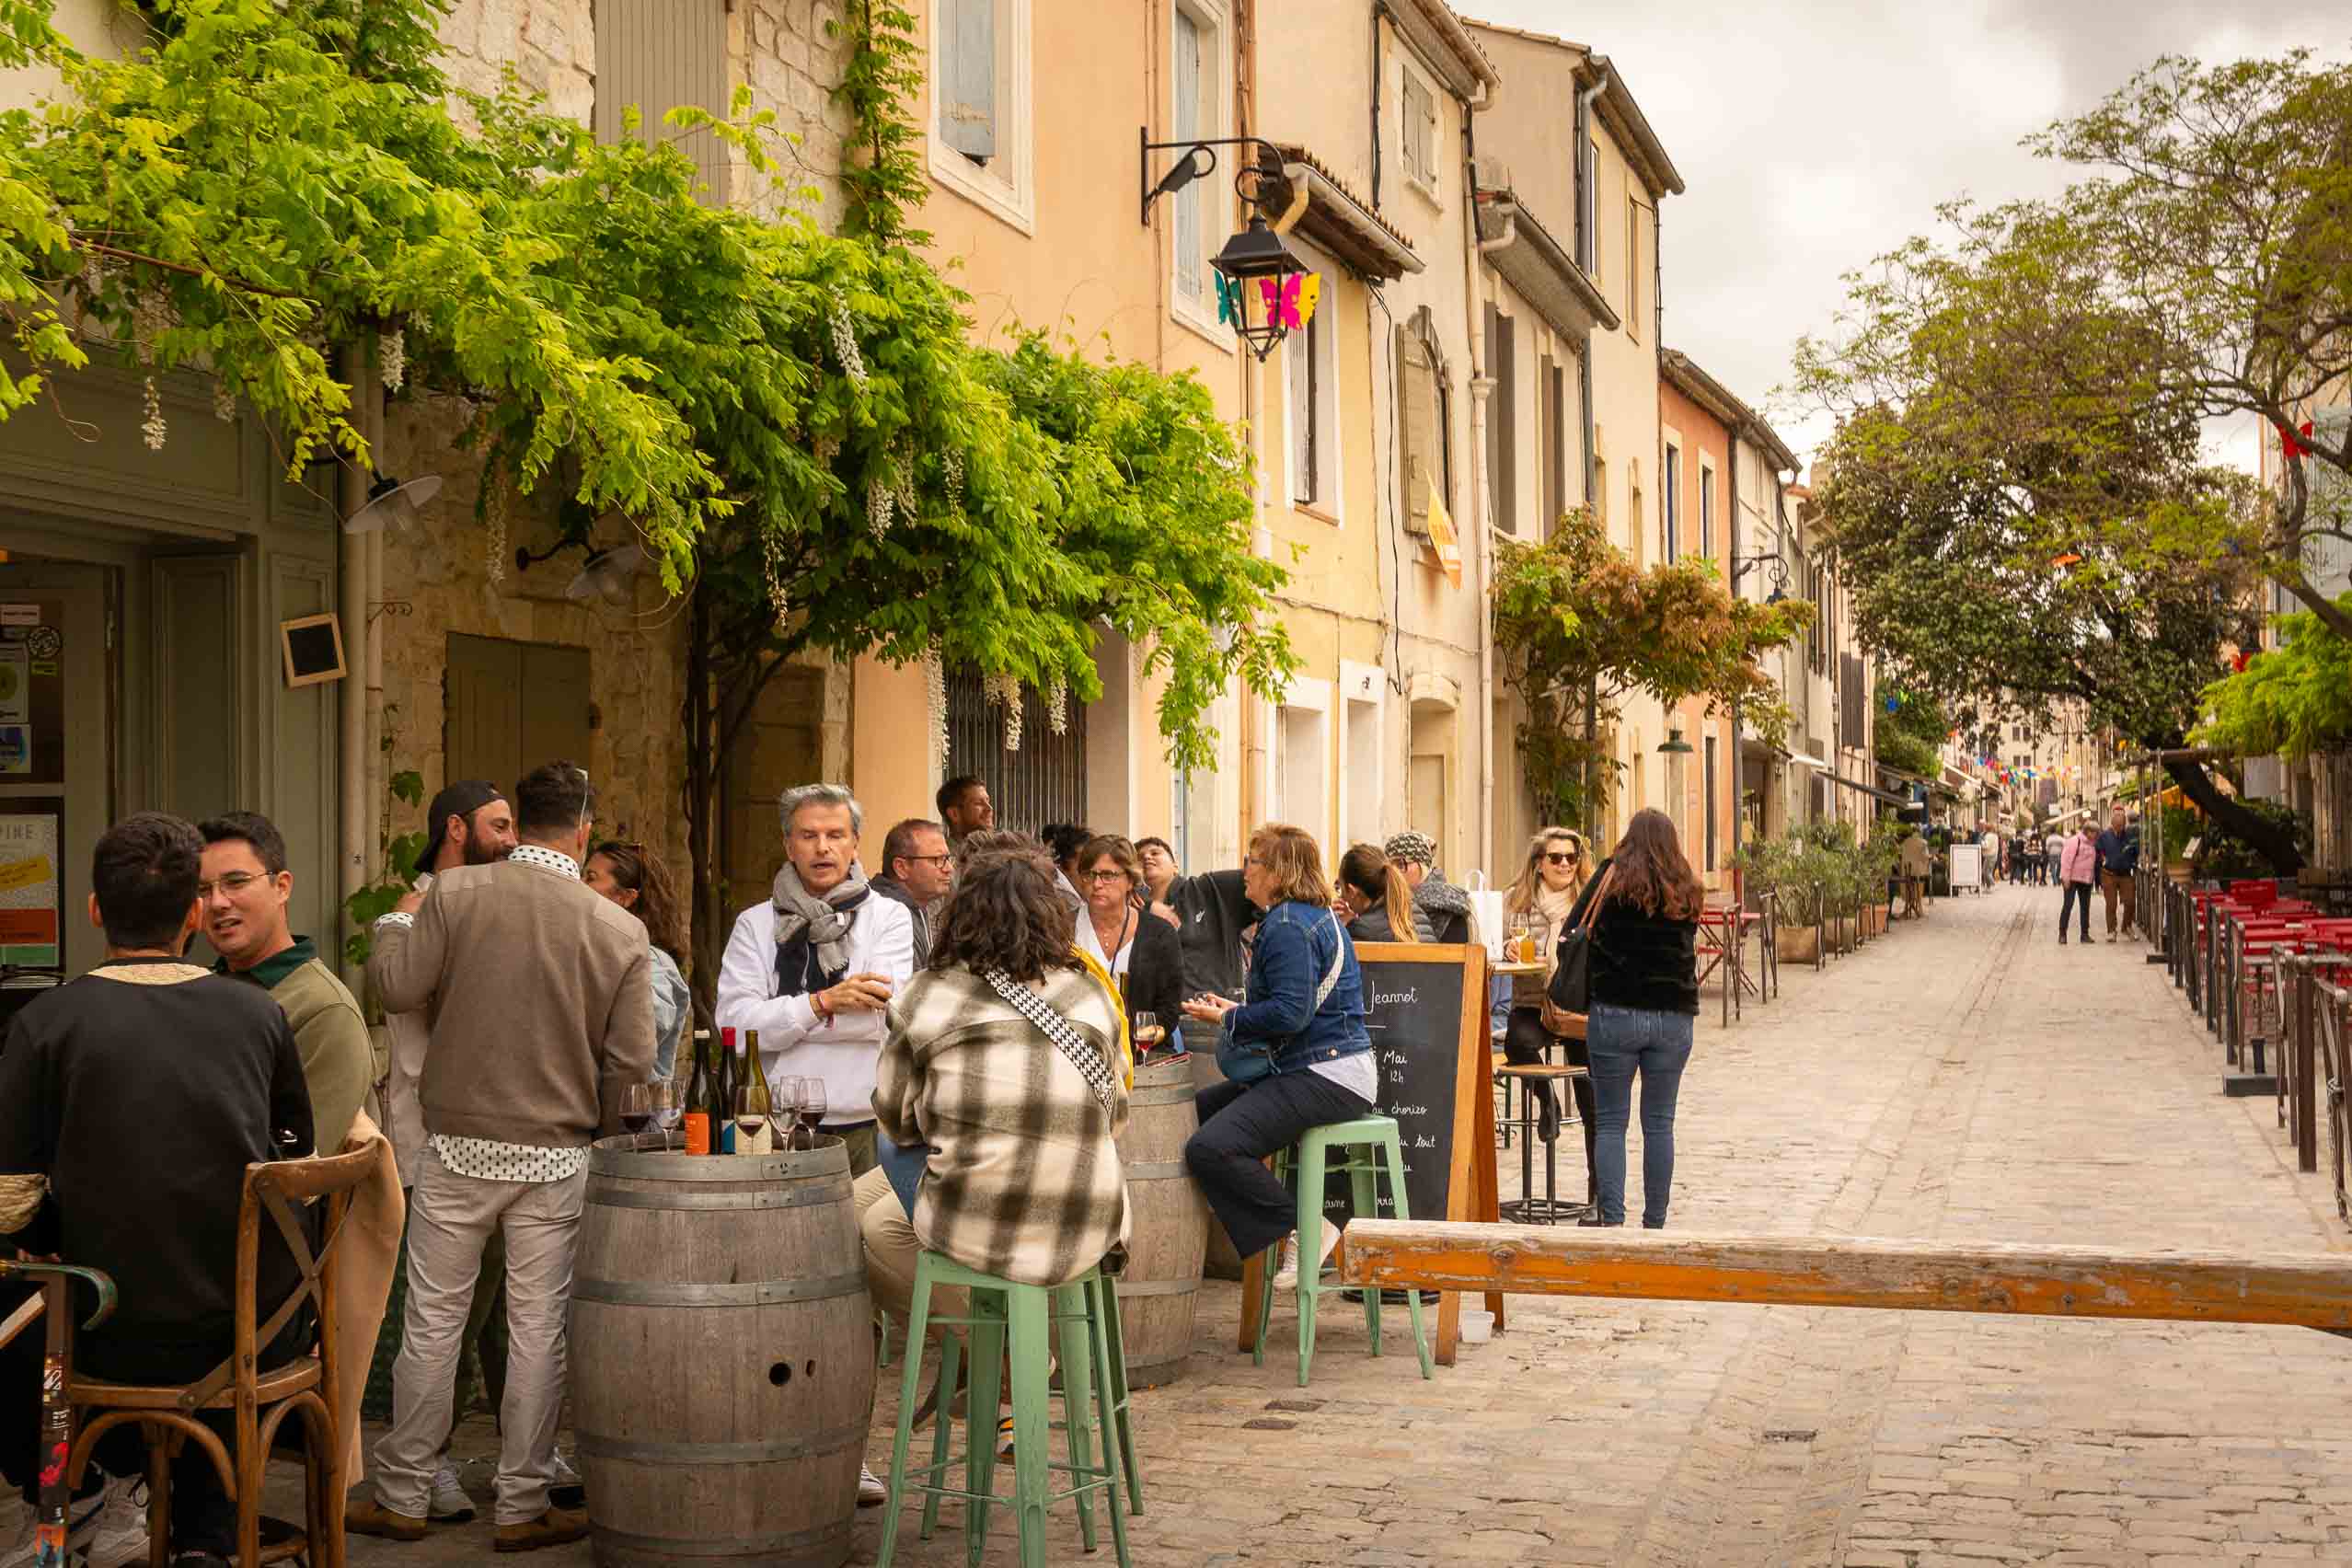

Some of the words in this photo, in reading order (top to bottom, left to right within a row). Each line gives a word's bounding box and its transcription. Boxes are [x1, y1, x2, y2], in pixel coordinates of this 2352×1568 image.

[1364, 980, 1418, 1014] Jeannot
[1383, 1050, 1408, 1064] Mai
[1390, 1070, 1404, 1082] 12h
[1391, 1100, 1427, 1115] chorizo
[1415, 1134, 1435, 1147] tout
